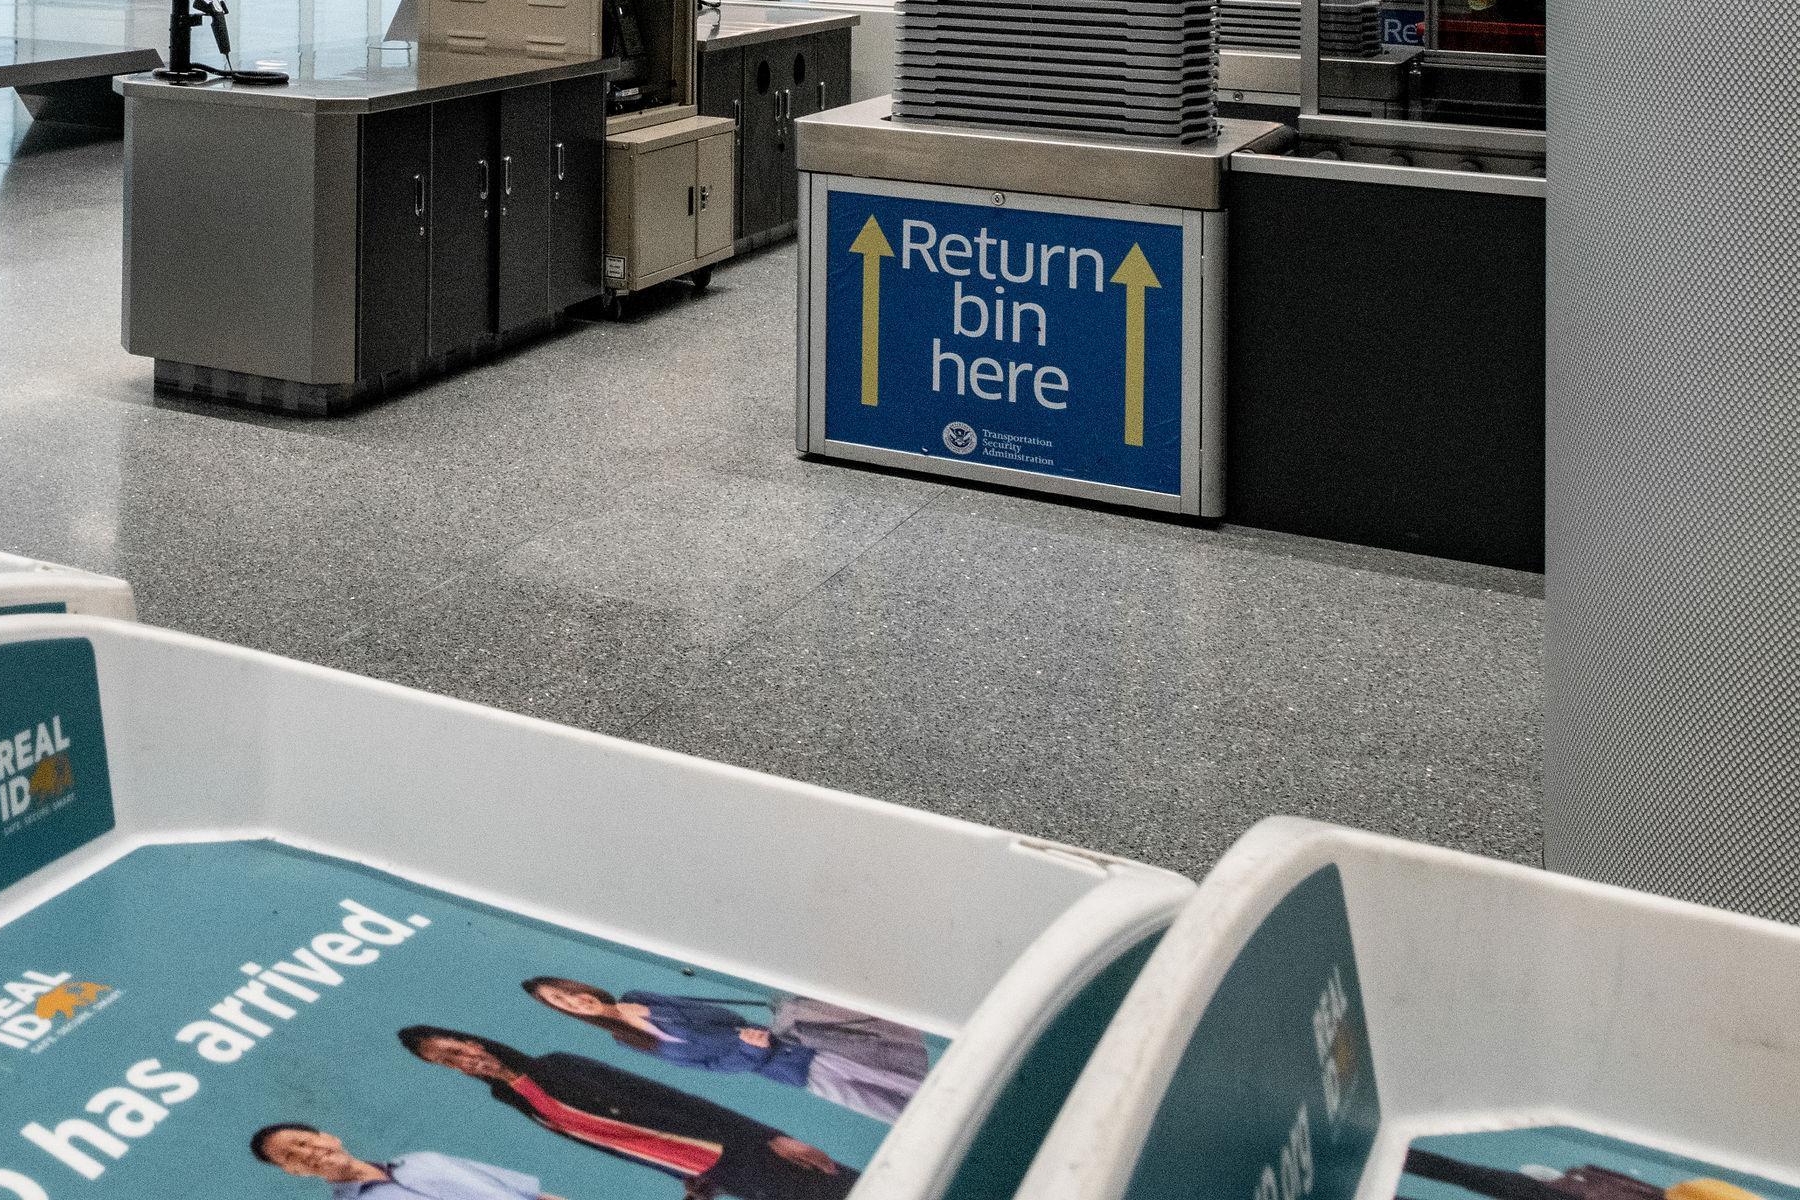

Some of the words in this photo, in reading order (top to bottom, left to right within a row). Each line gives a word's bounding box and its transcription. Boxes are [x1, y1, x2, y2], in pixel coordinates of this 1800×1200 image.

[902, 218, 1104, 292] Return
[953, 281, 1047, 346] bin
[932, 338, 1069, 410] here
[982, 429, 1053, 447] Transportation
[982, 438, 1022, 453] Security
[982, 447, 1055, 466] Administration
[0, 775, 31, 822] ID
[19, 1057, 200, 1181] has
[173, 899, 432, 1064] arrived.
